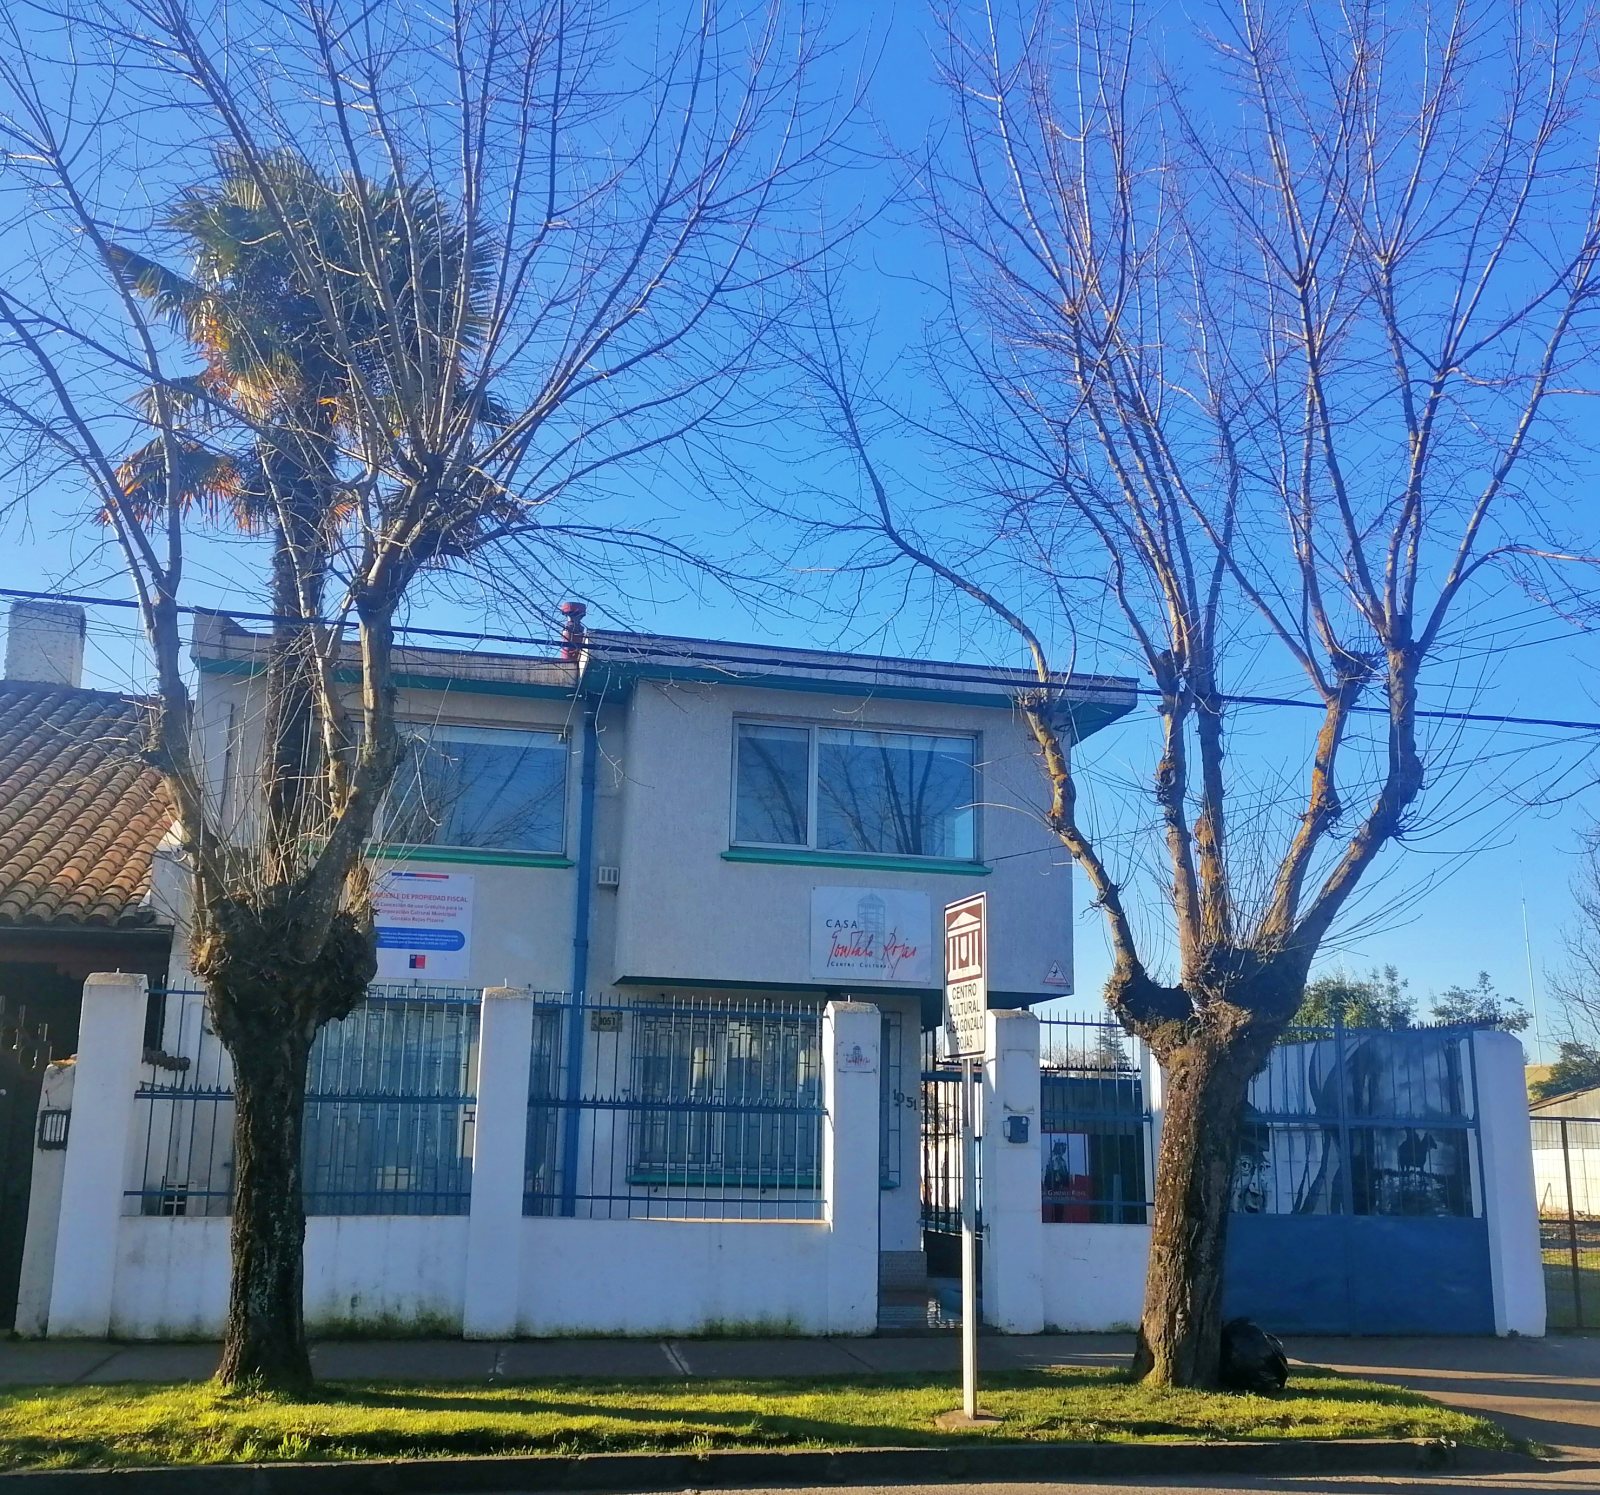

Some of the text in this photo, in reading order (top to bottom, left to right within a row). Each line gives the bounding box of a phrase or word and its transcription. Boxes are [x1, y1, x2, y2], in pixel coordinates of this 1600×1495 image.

[411, 893, 446, 901] PROPIEDAD
[447, 895, 468, 903] FISCAL
[825, 918, 858, 929] CASA
[952, 982, 977, 1000] CENTRO
[948, 999, 981, 1017] CULTURAL
[946, 1015, 984, 1035] CASA GONZALO
[956, 1034, 974, 1050] ROJAS
